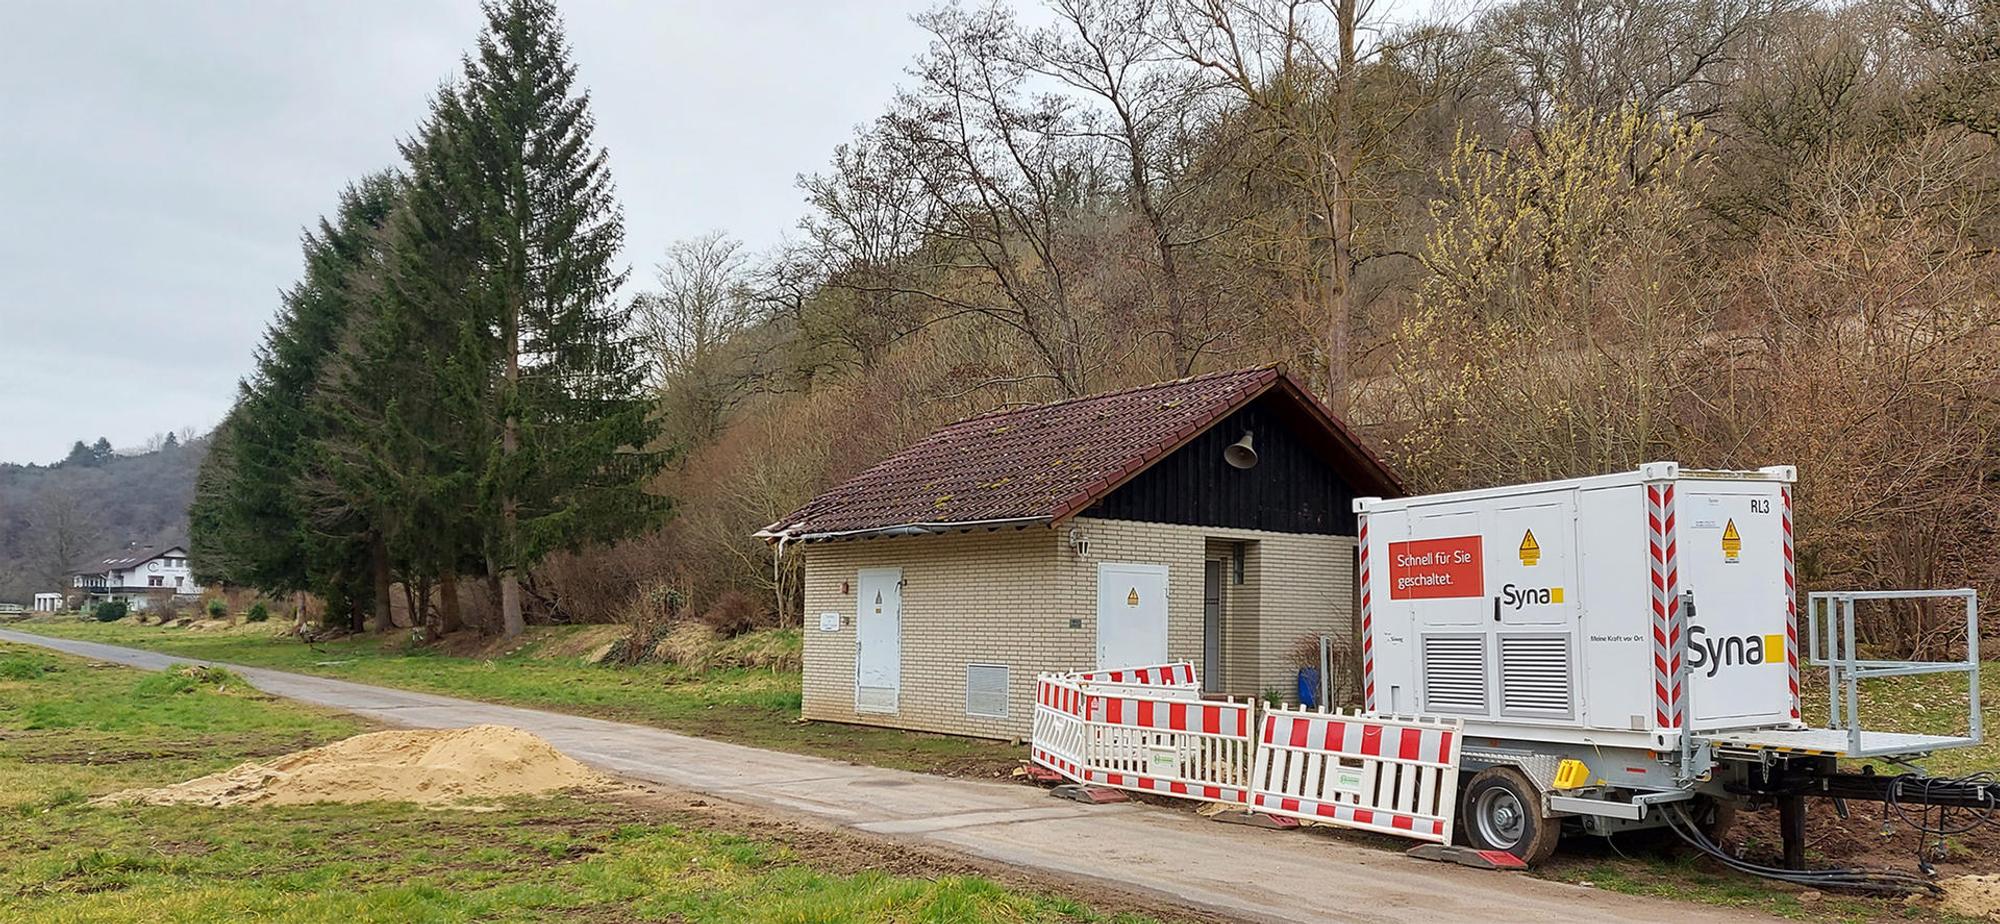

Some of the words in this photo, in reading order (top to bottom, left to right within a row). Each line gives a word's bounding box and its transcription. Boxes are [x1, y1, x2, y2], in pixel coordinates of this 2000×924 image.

[1750, 499, 1770, 514] RL3
[1397, 552, 1433, 567] Schnell
[1435, 551, 1451, 565] für
[1453, 550, 1472, 564] Sie
[1398, 572, 1454, 590] geschaltet.
[1503, 583, 1550, 610] Syna
[1687, 625, 1764, 678] Syna
